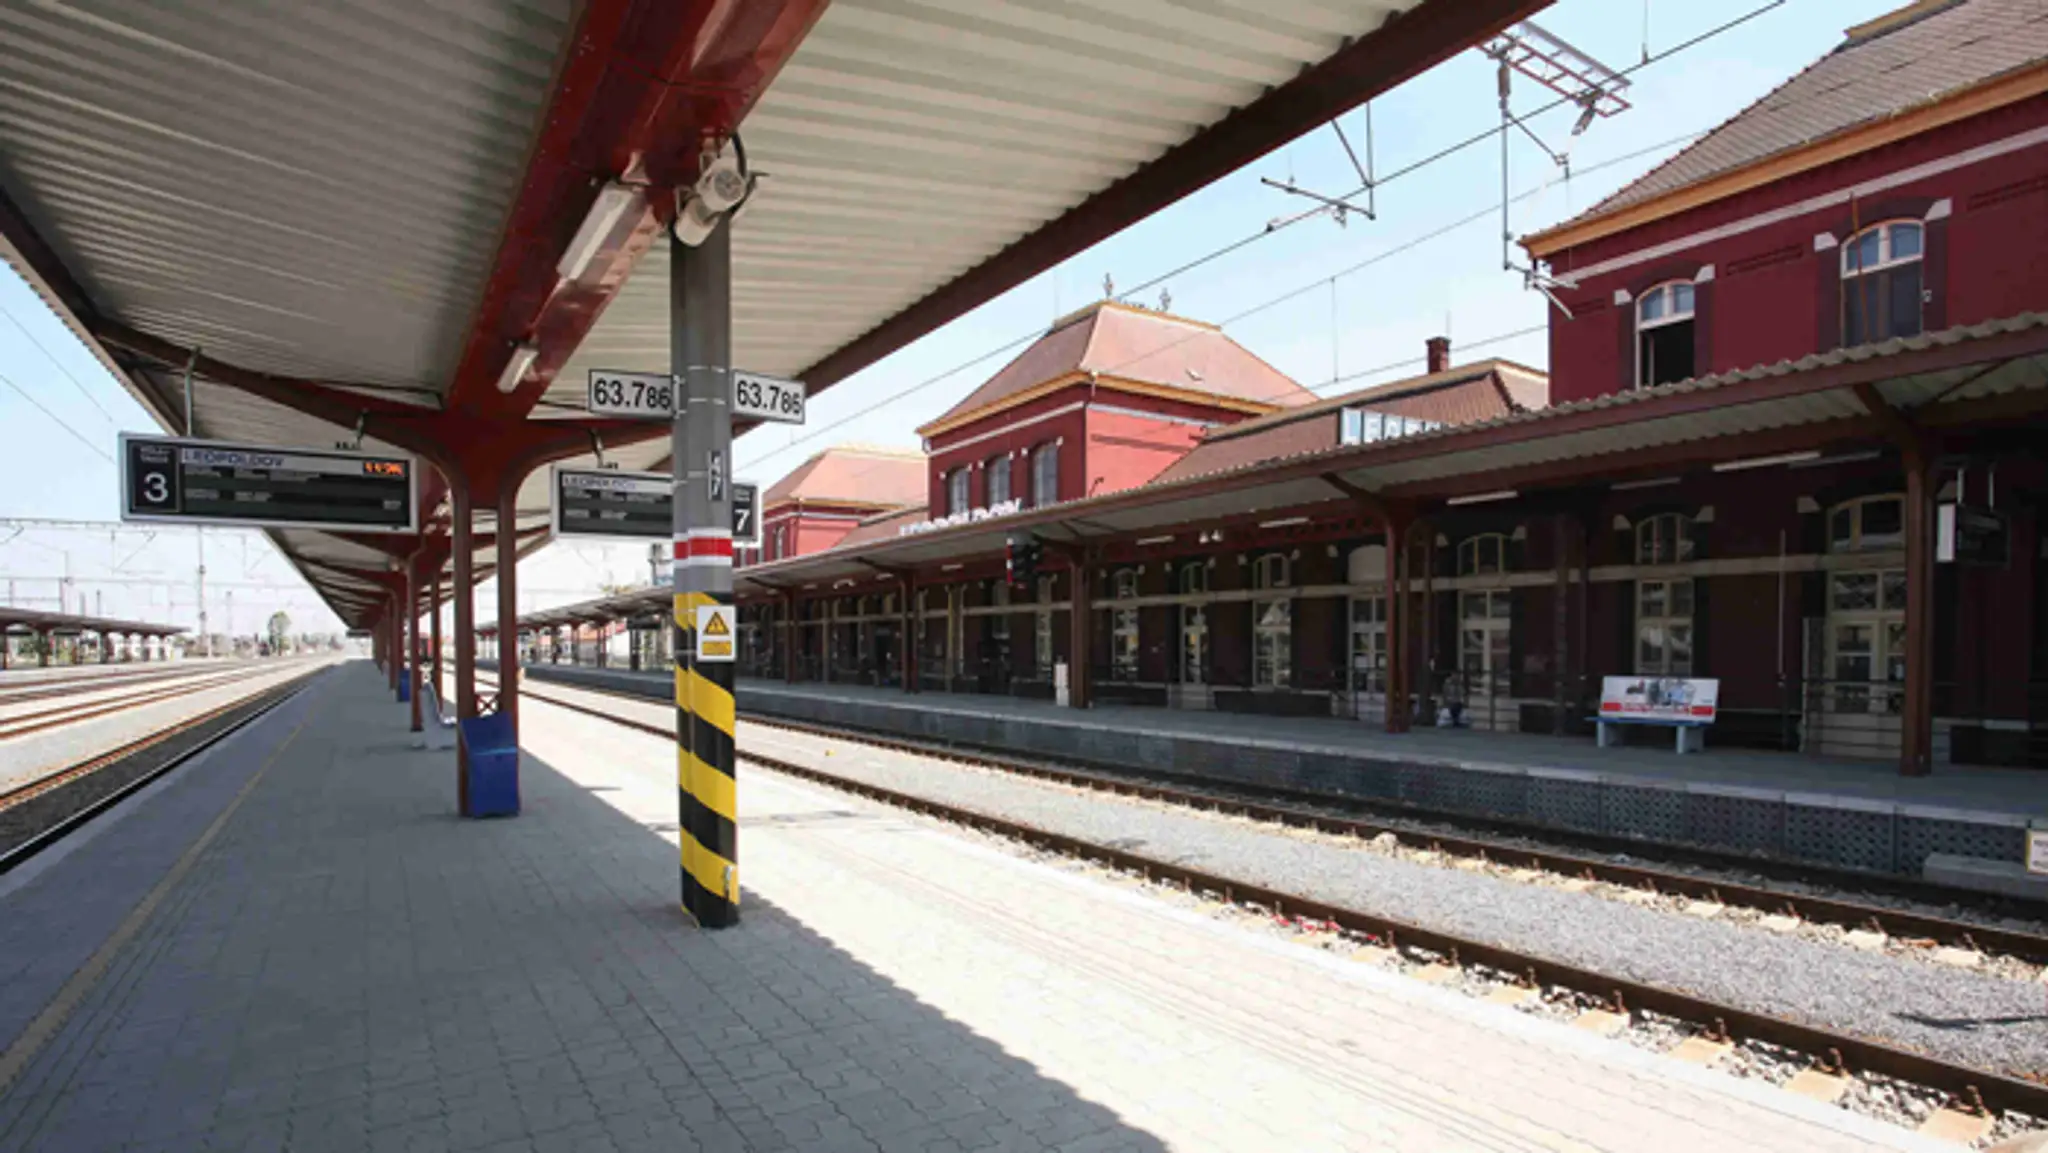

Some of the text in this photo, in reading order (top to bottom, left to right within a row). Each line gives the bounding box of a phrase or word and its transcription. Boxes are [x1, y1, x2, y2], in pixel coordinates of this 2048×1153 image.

[594, 378, 672, 410] 63.786
[736, 379, 801, 414] 63.786
[144, 472, 168, 502] 3
[735, 508, 750, 531] 7
